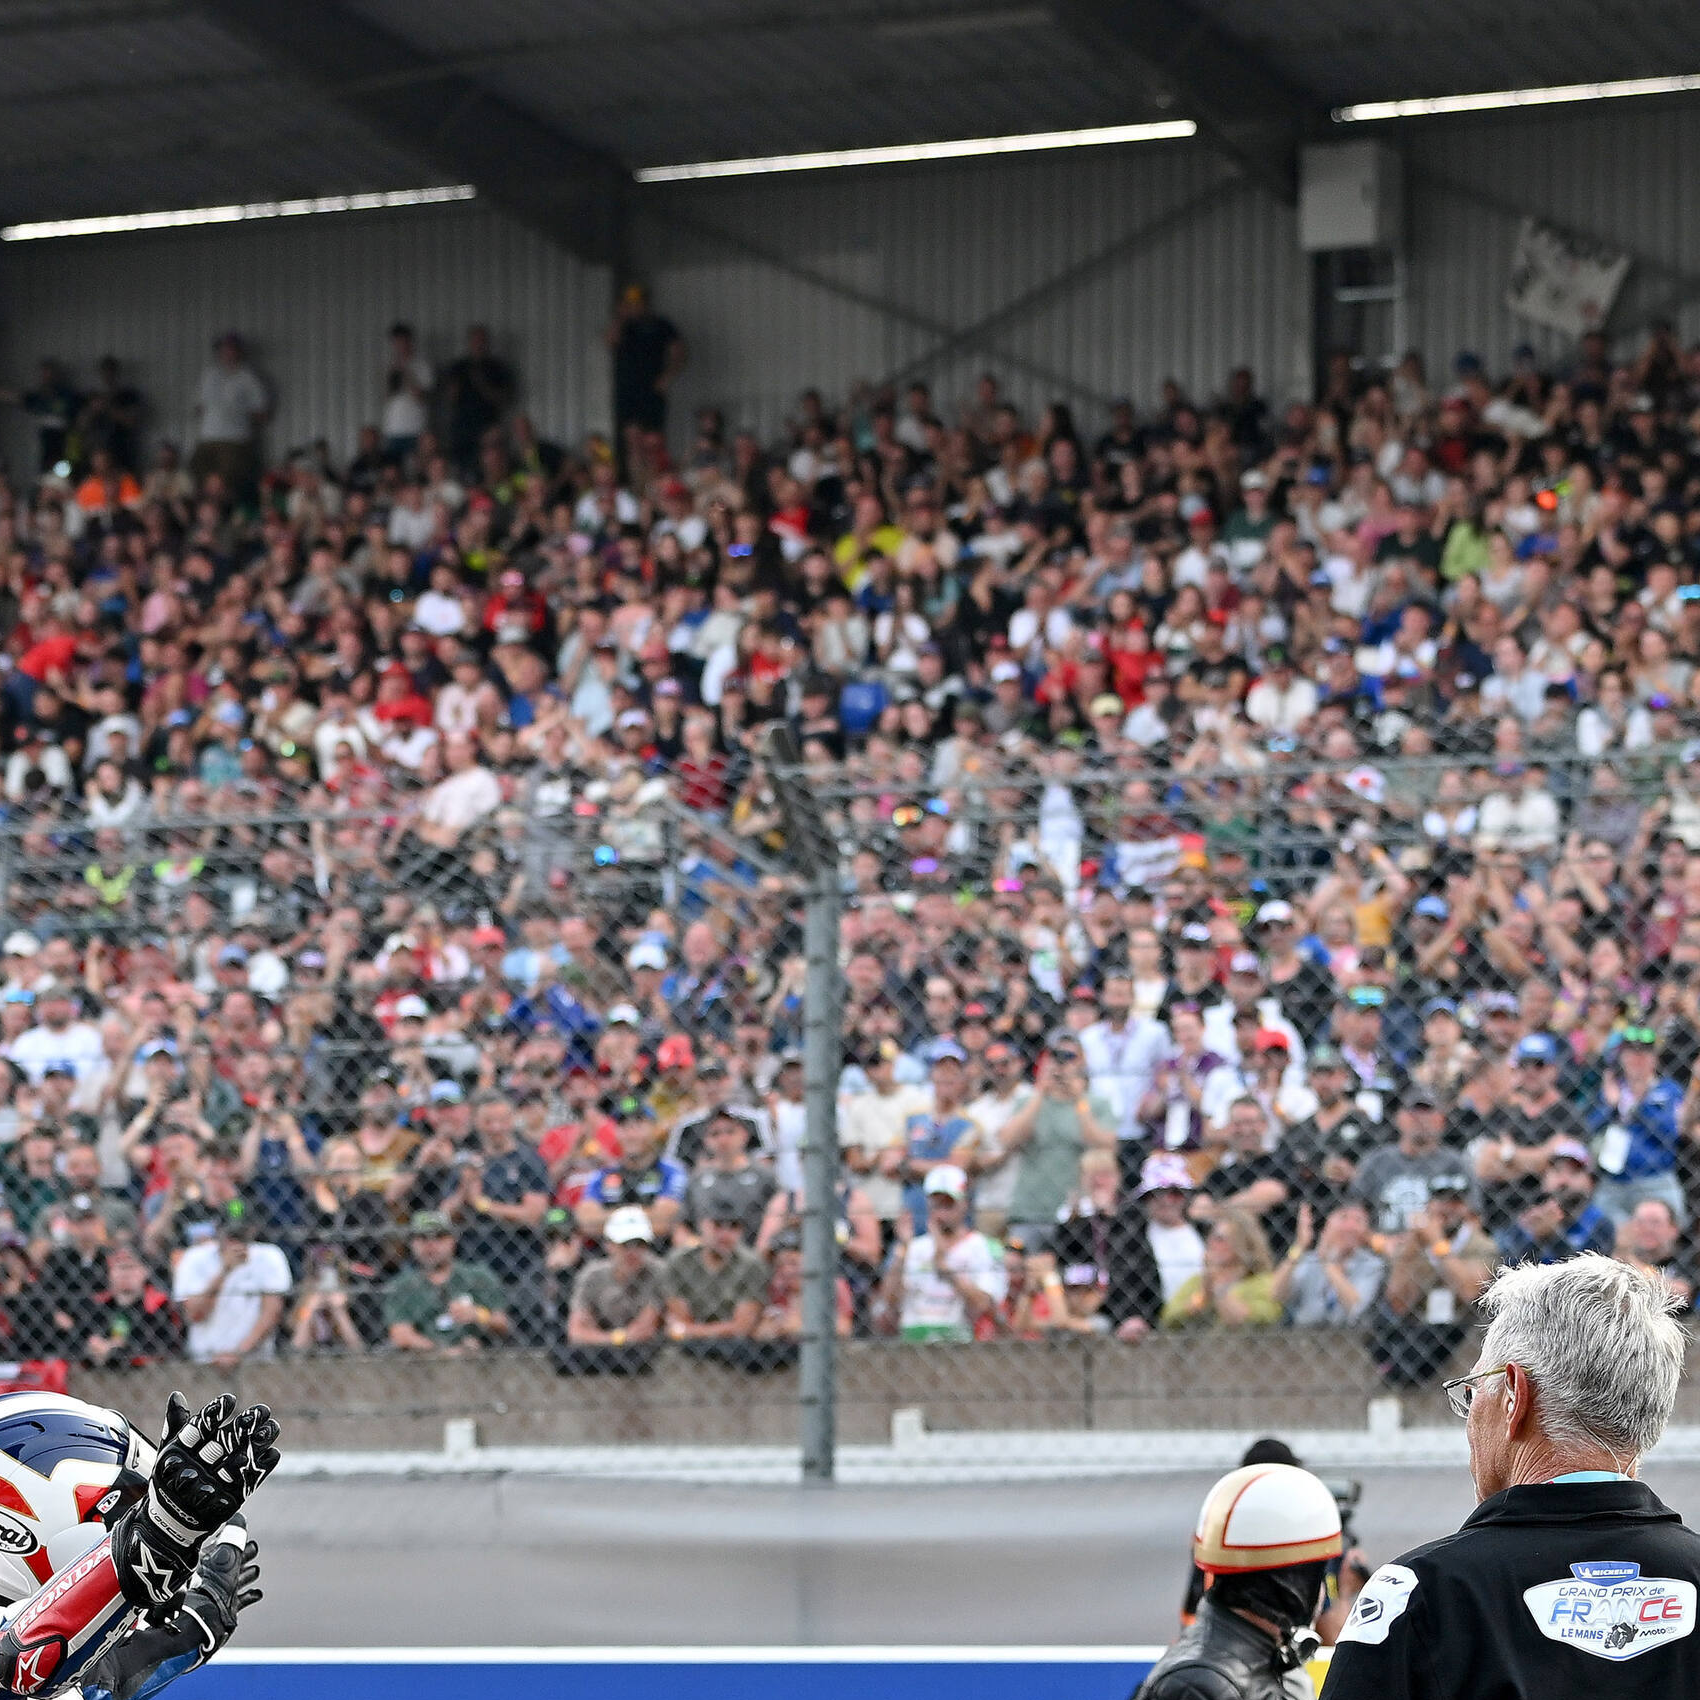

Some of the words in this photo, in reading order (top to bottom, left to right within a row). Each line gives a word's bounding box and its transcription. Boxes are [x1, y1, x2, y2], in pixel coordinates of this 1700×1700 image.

[1592, 1568, 1635, 1577] MICHELIN
[17, 1542, 112, 1636] HONDA
[1558, 1587, 1608, 1599] GRAND
[1610, 1586, 1647, 1598] PRIX
[1649, 1586, 1666, 1596] de
[1549, 1597, 1685, 1626] FRANCE
[1575, 1628, 1604, 1640] MANS
